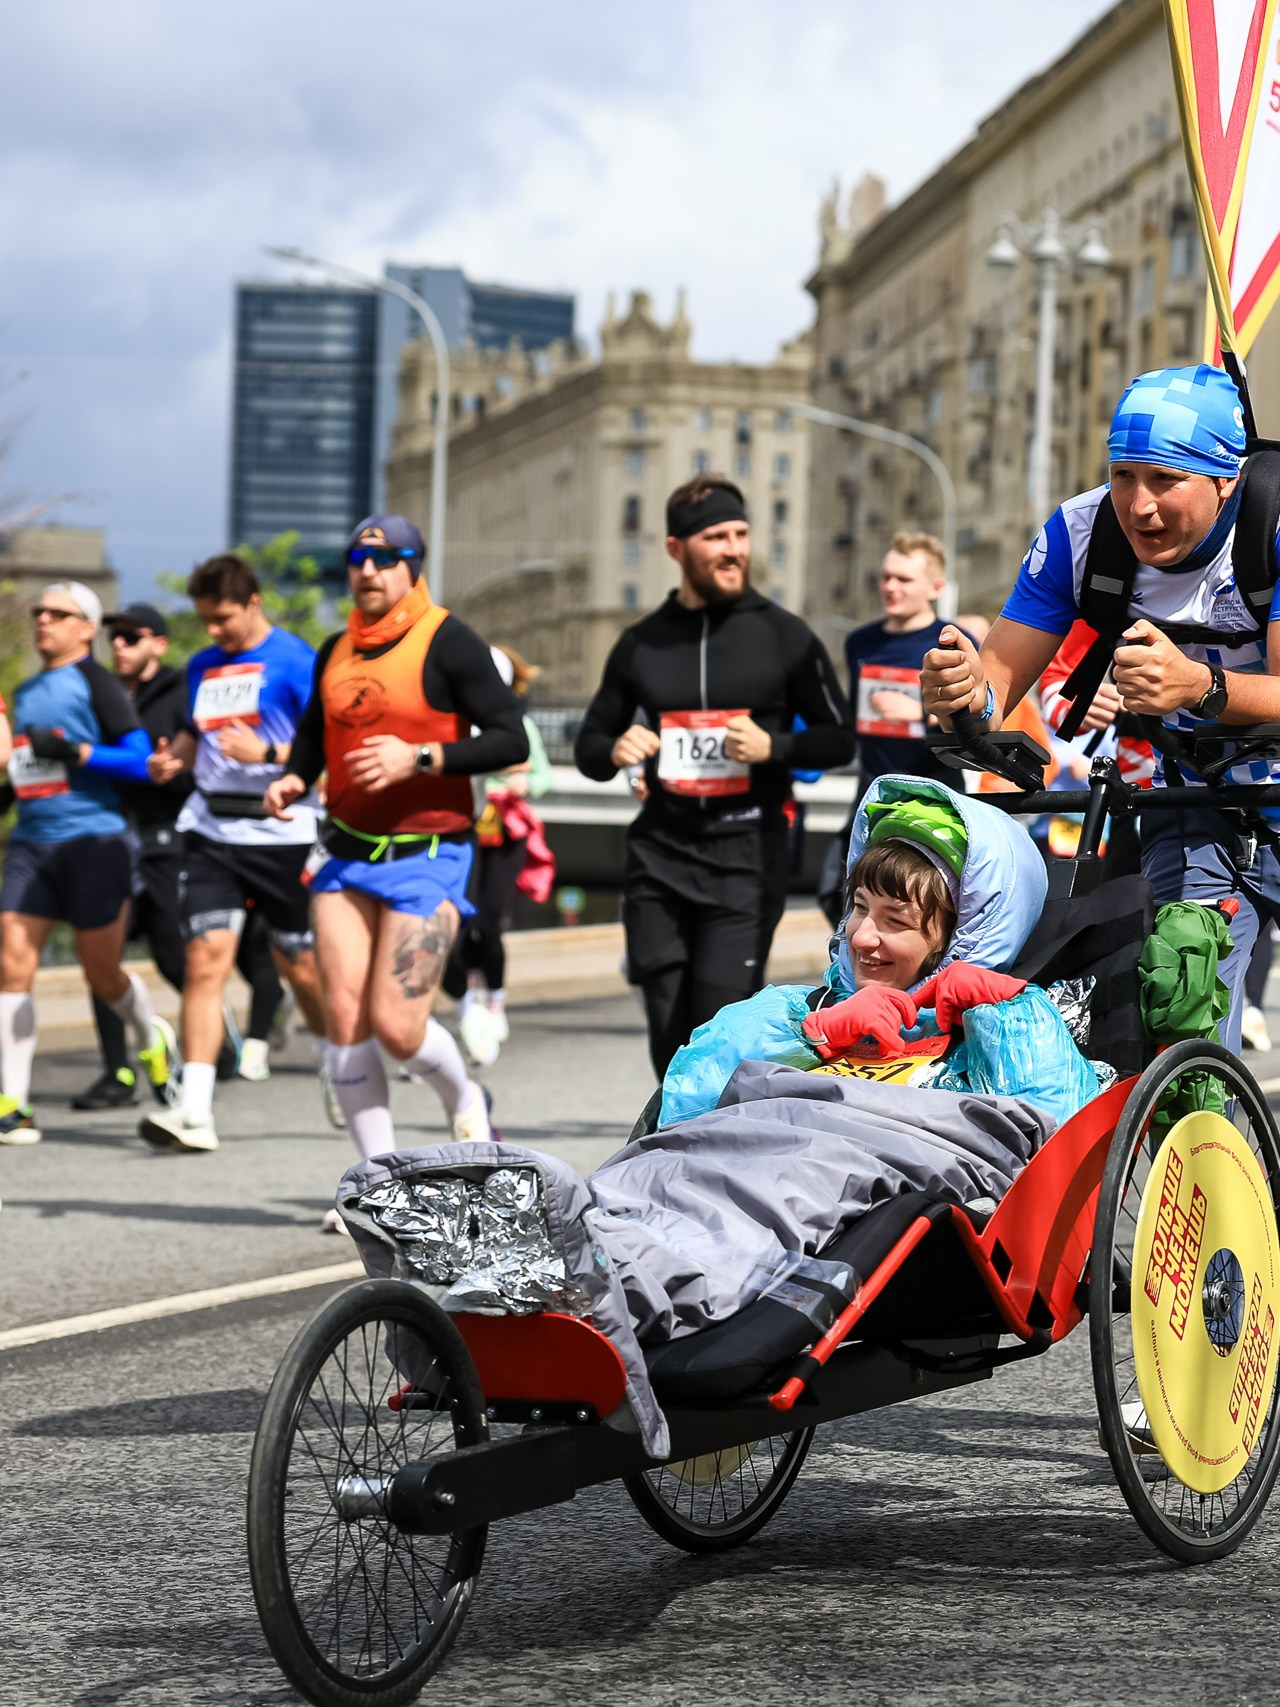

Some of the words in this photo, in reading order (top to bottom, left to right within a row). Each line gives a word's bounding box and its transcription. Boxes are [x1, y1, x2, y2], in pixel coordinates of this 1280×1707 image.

[1145, 1148, 1183, 1298] БОЛЬШЕ
[1165, 1207, 1188, 1277] ЧЕМ
[1170, 1190, 1207, 1338] МОЖЕШЬ
[1229, 1275, 1262, 1420] МОЖЕШЬ
[1243, 1308, 1274, 1452] БОЛЬШЕ
[1244, 1332, 1263, 1396] ЧЕМ
